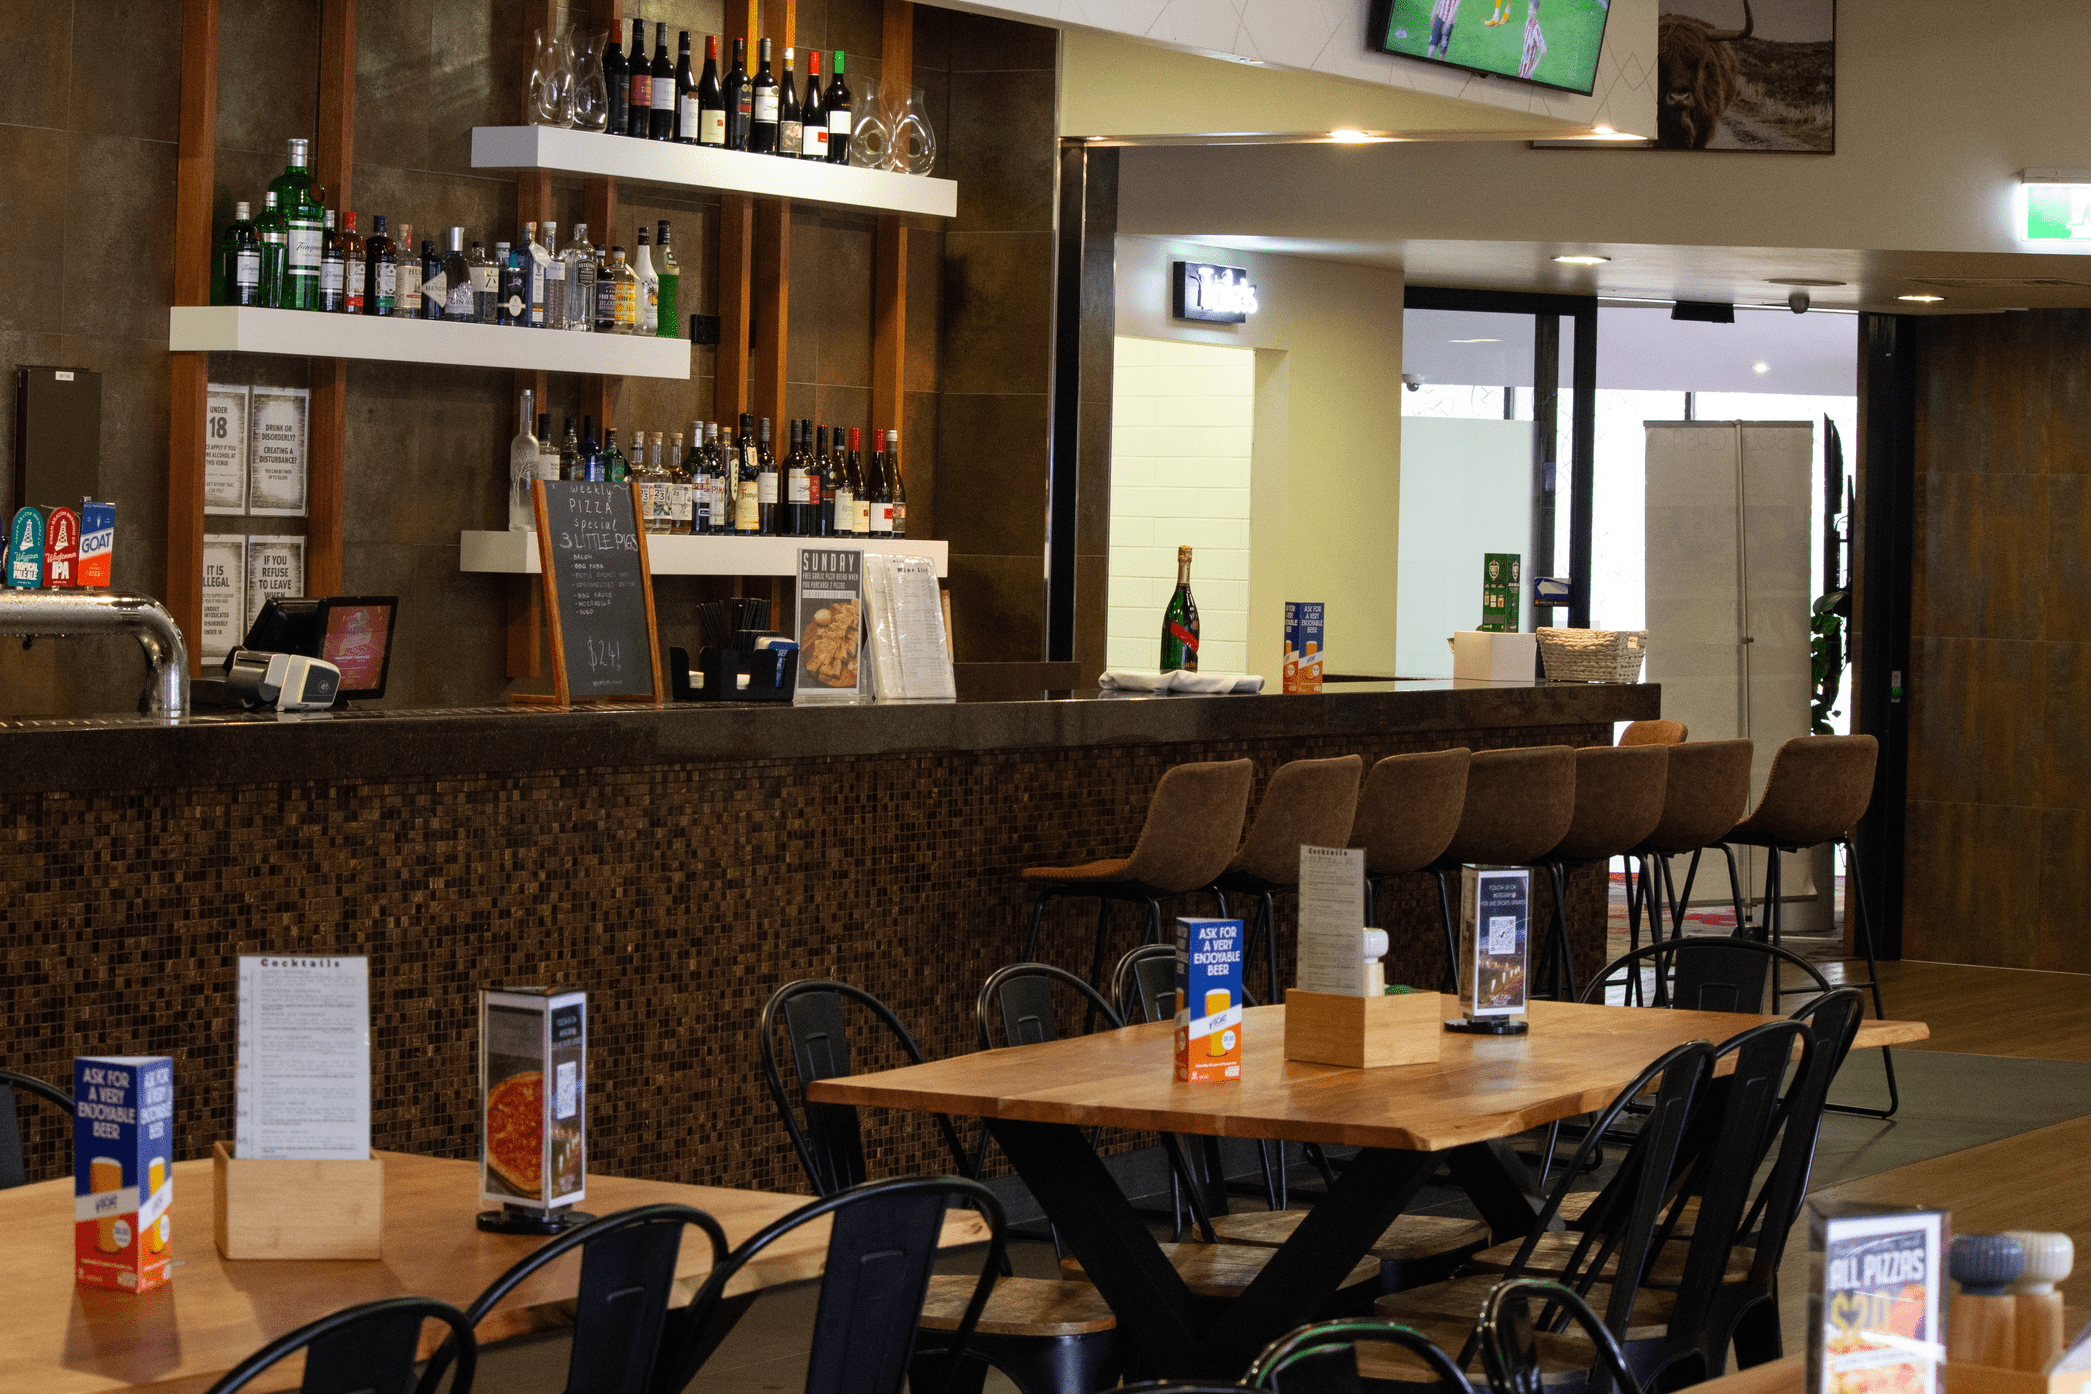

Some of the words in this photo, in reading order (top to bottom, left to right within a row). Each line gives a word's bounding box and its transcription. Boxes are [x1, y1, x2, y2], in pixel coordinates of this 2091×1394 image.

[209, 416, 227, 438] 18
[262, 433, 296, 442] DISORDERLY?
[264, 446, 288, 454] CREATING
[259, 456, 298, 464] DISTURBANCE?
[570, 484, 613, 502] weekly
[654, 489, 664, 500] 23
[569, 498, 612, 515] PIZZA
[574, 517, 616, 532] special
[82, 533, 111, 553] GOAT
[559, 532, 573, 548] 3
[574, 533, 613, 550] LITTLE
[615, 533, 638, 551] PIGS
[13, 561, 38, 571] TROPICAL
[264, 555, 270, 565] IF
[272, 555, 287, 565] YOU
[803, 553, 854, 572] SUNDAY
[13, 570, 27, 580] PALE
[27, 570, 37, 580] ALE
[52, 561, 69, 579] IPA
[207, 565, 215, 575] IT
[216, 566, 224, 576] IS
[262, 568, 288, 578] REFUSE
[203, 577, 230, 587] LLEGAL
[259, 580, 268, 589] TO
[270, 580, 291, 590] LEAVE
[1309, 848, 1347, 856] Cocktails
[1199, 928, 1217, 939] ASK
[1220, 926, 1237, 938] FOR
[1203, 940, 1211, 951] A
[1213, 939, 1233, 950] VERY
[261, 958, 340, 968] Cocktails
[1194, 951, 1241, 964] ENJOYABLE
[1207, 964, 1229, 976] BEER
[83, 1068, 105, 1085] ASK
[107, 1070, 130, 1088] FOR
[88, 1086, 97, 1101] A
[99, 1087, 125, 1105] VERY
[78, 1101, 136, 1124] ENJOYABLE
[93, 1121, 120, 1140] BEER
[1830, 1258, 1862, 1290] ALL
[1864, 1248, 1925, 1286] PIZZAS
